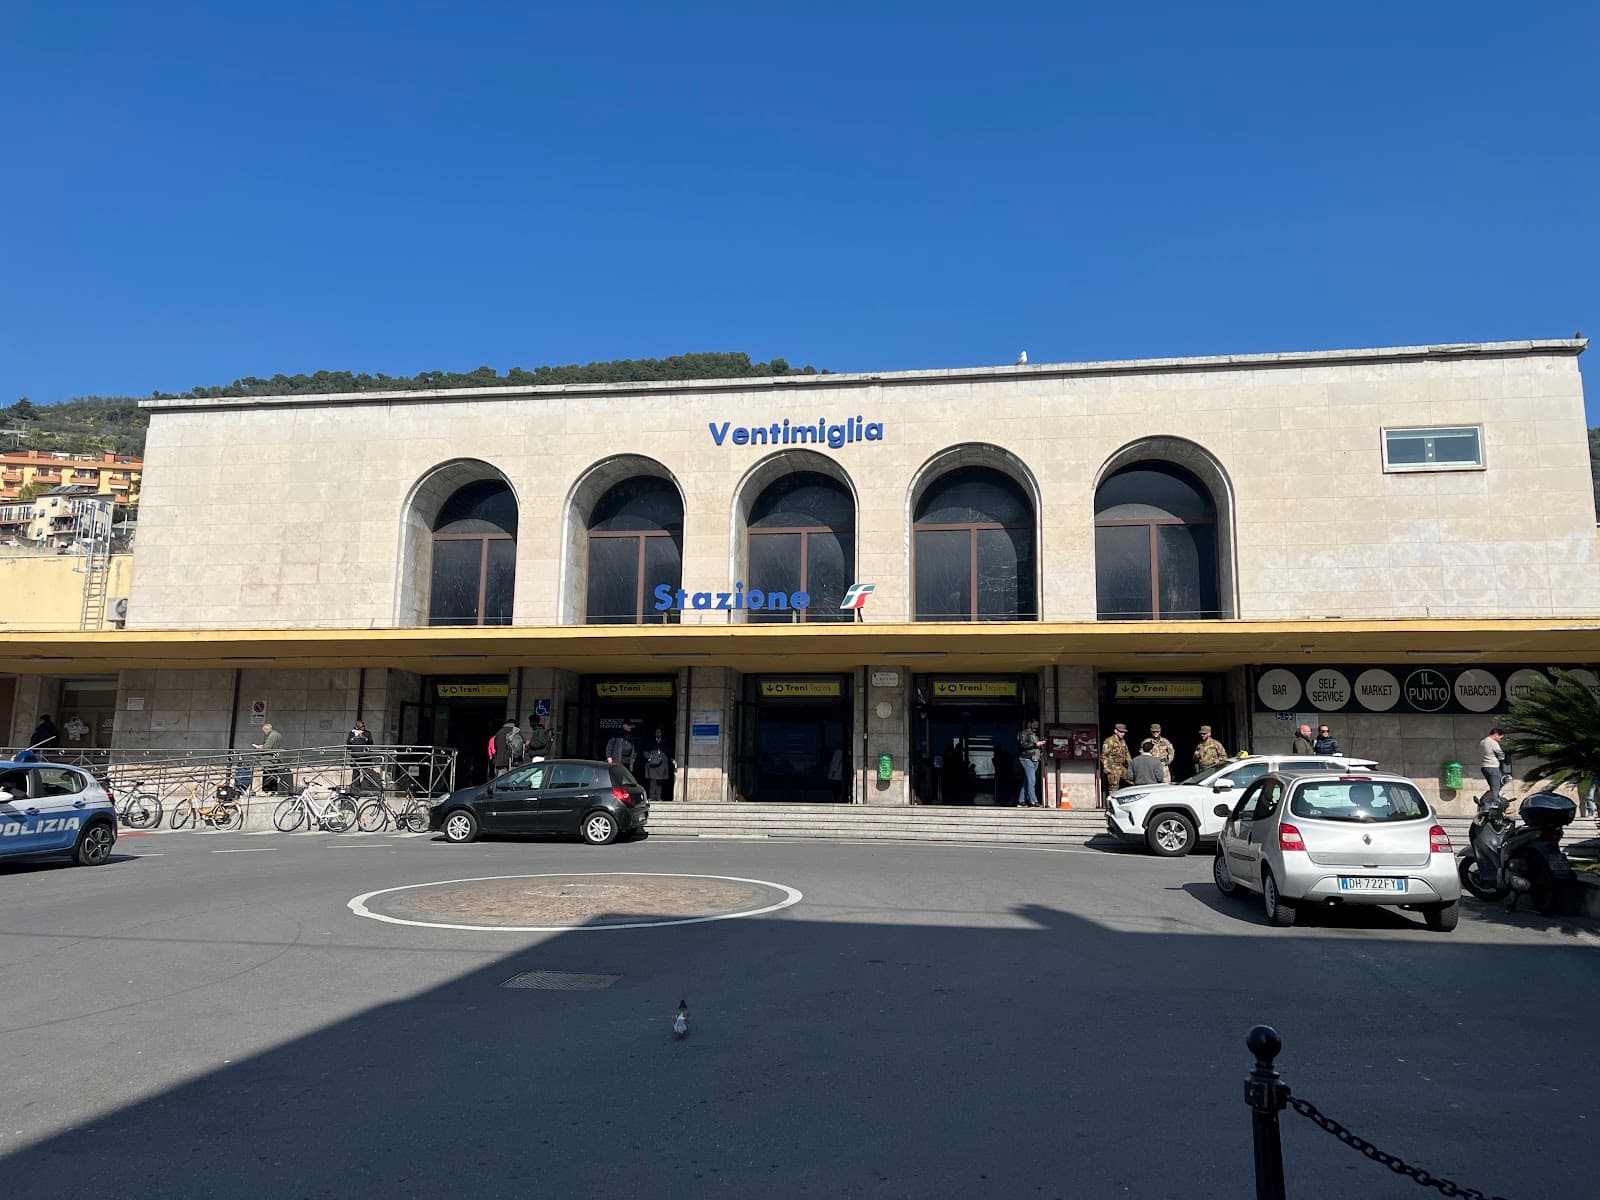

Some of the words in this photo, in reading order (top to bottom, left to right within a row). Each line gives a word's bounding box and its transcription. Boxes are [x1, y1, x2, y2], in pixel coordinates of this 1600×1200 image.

[708, 415, 884, 448] Ventimiglia
[653, 581, 811, 611] Stazione
[1318, 678, 1337, 689] SELF
[1421, 672, 1433, 685] IL
[459, 685, 480, 693] Treni
[619, 684, 641, 692] Treni
[786, 684, 808, 692] Treni
[1143, 684, 1168, 693] Treni
[1272, 684, 1287, 695] BAR
[1361, 684, 1392, 696] MARKET
[1459, 685, 1497, 697] TABACCHI
[1312, 691, 1344, 703] SERVICE
[1409, 687, 1447, 702] PUNTO
[1349, 879, 1361, 888] DH
[1365, 879, 1396, 888] 722FY
